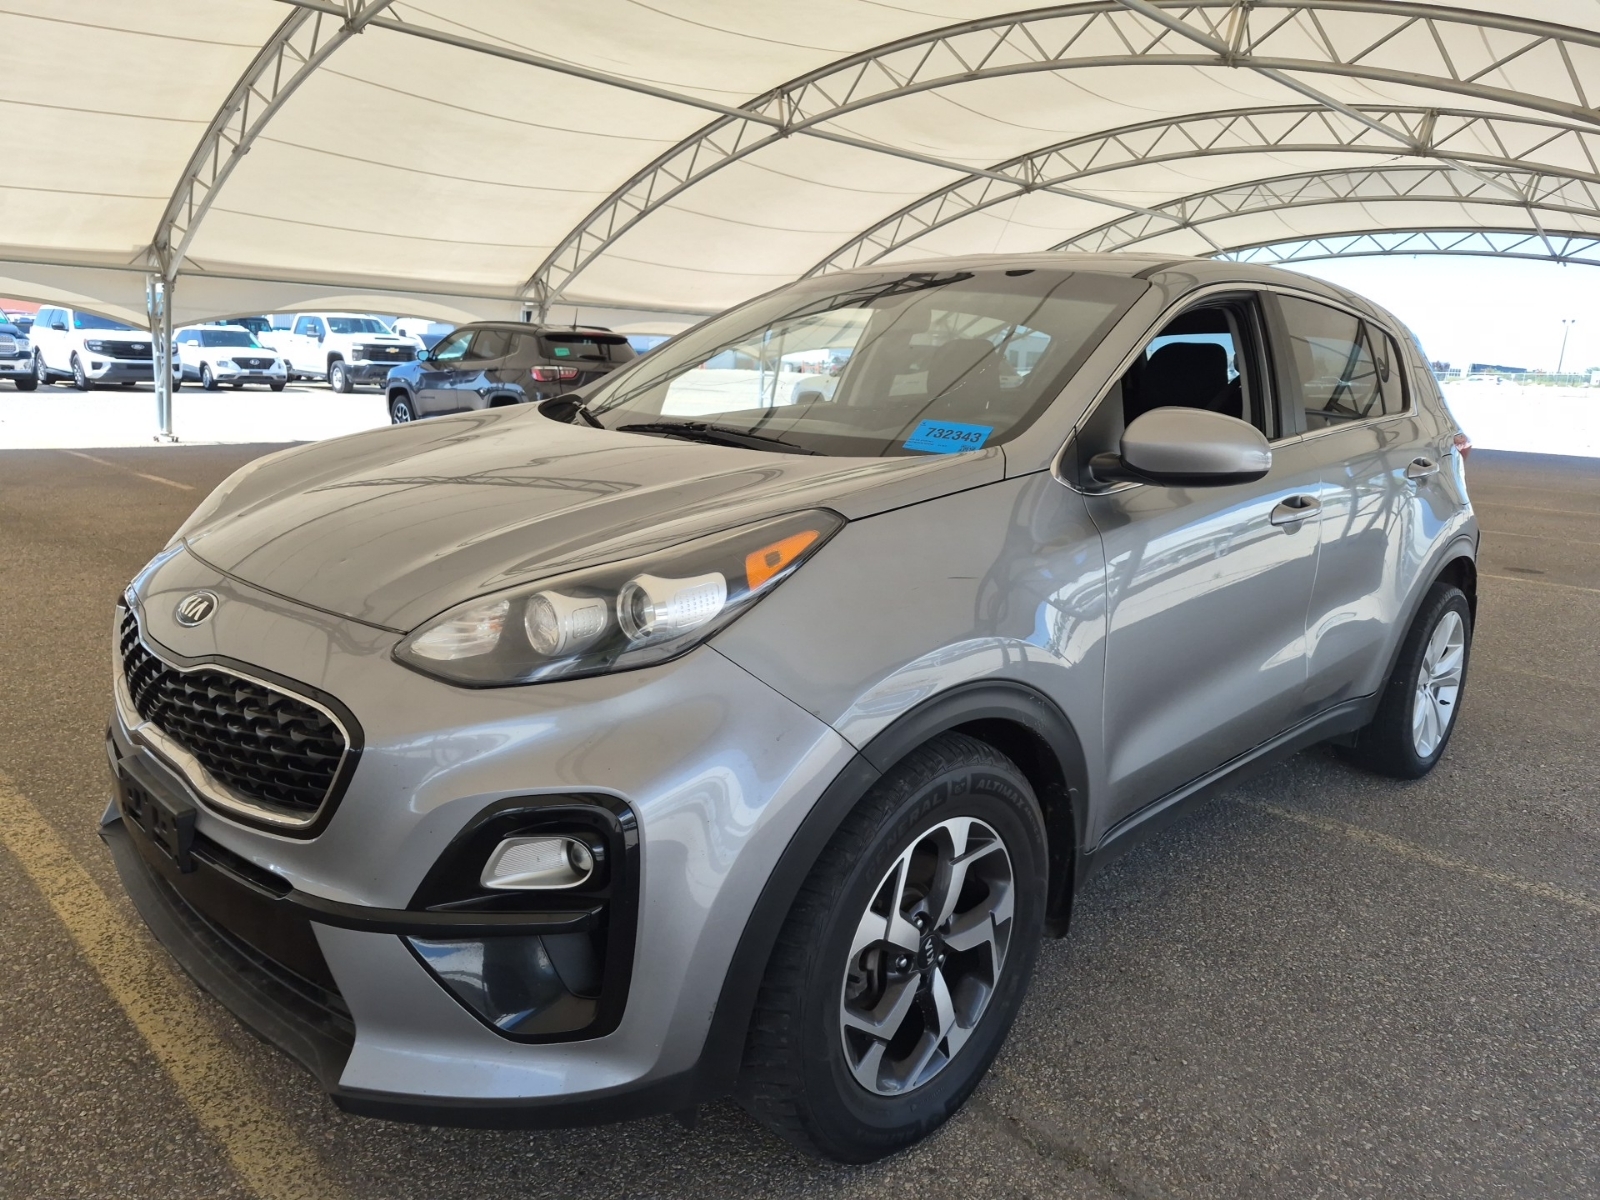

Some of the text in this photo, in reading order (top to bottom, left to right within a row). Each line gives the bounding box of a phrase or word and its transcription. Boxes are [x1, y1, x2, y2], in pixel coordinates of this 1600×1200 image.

[924, 427, 982, 443] 732343
[180, 596, 209, 621] KIA
[864, 793, 943, 883] GENERAL
[976, 778, 1025, 809] ALTIMAX
[925, 938, 934, 965] KIA
